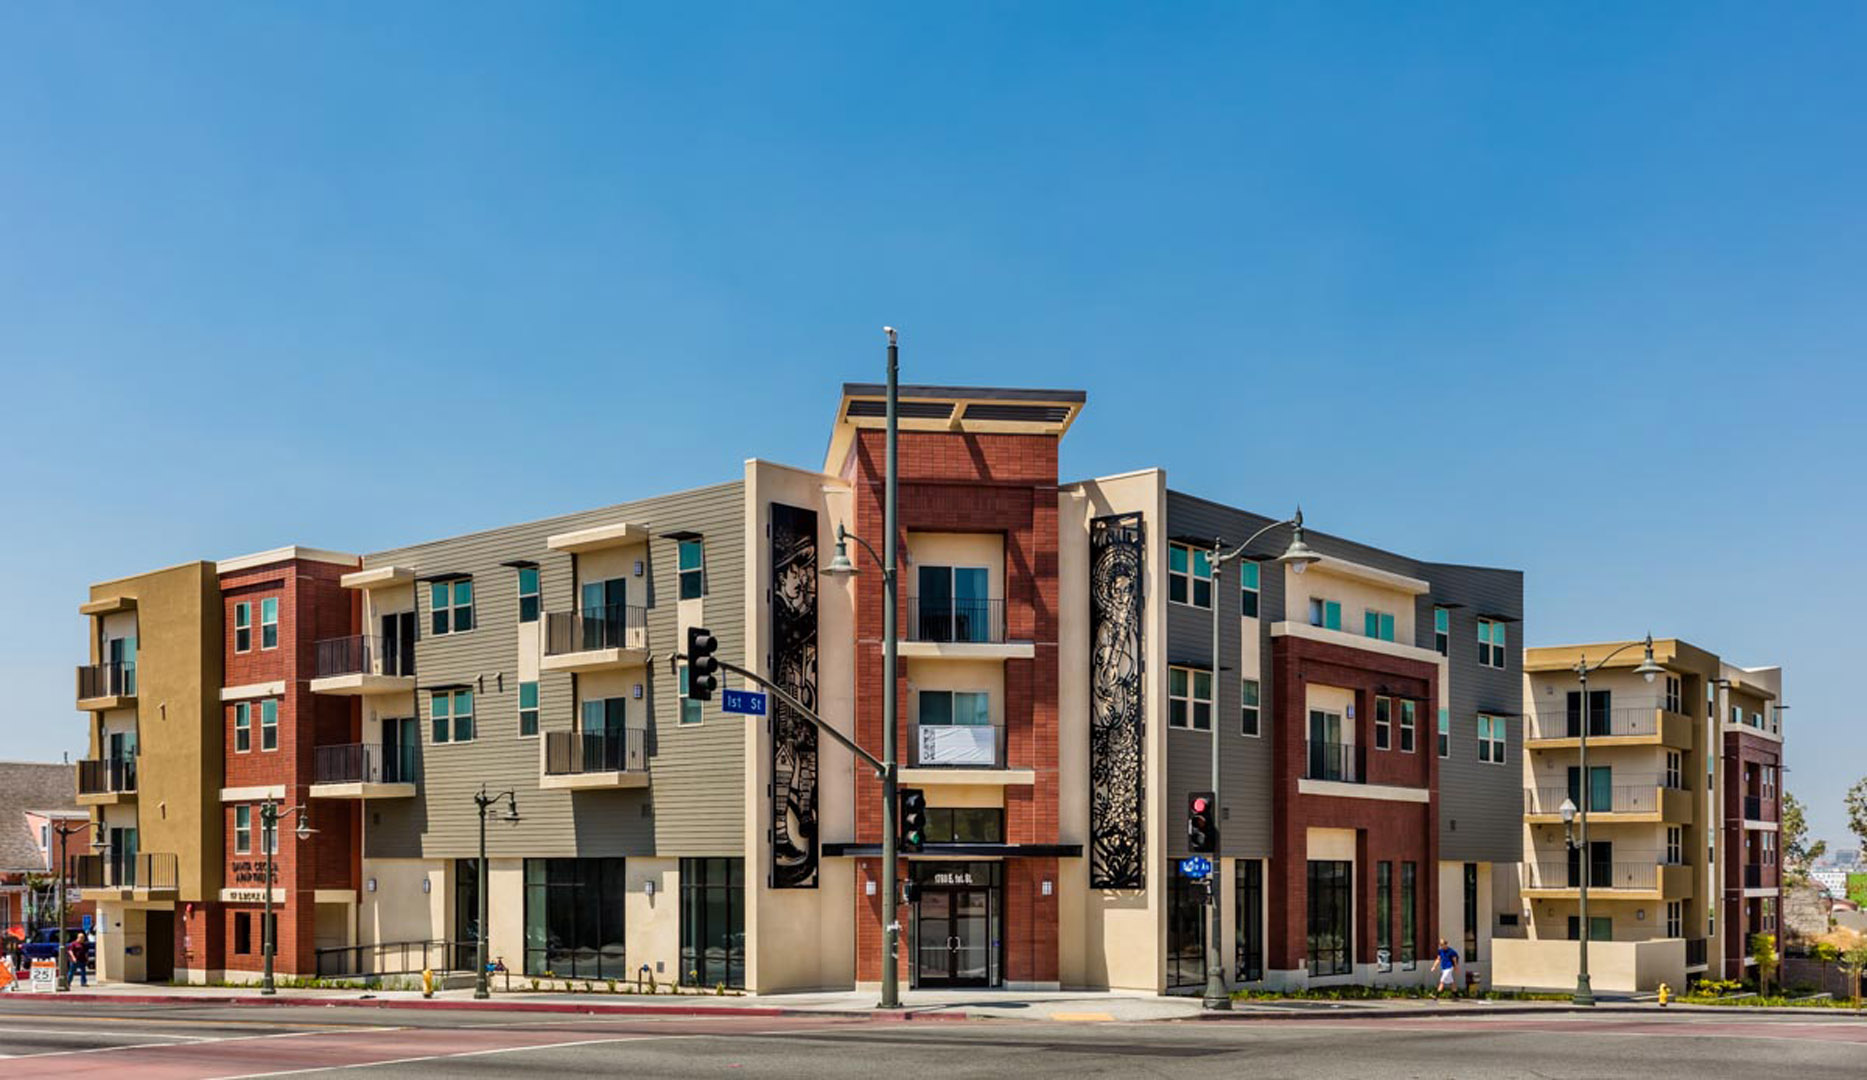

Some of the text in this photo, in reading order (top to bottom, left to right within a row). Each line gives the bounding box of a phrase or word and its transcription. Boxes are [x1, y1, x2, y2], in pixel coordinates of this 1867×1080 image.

[727, 694, 762, 710] 1st St
[33, 970, 49, 980] 25
